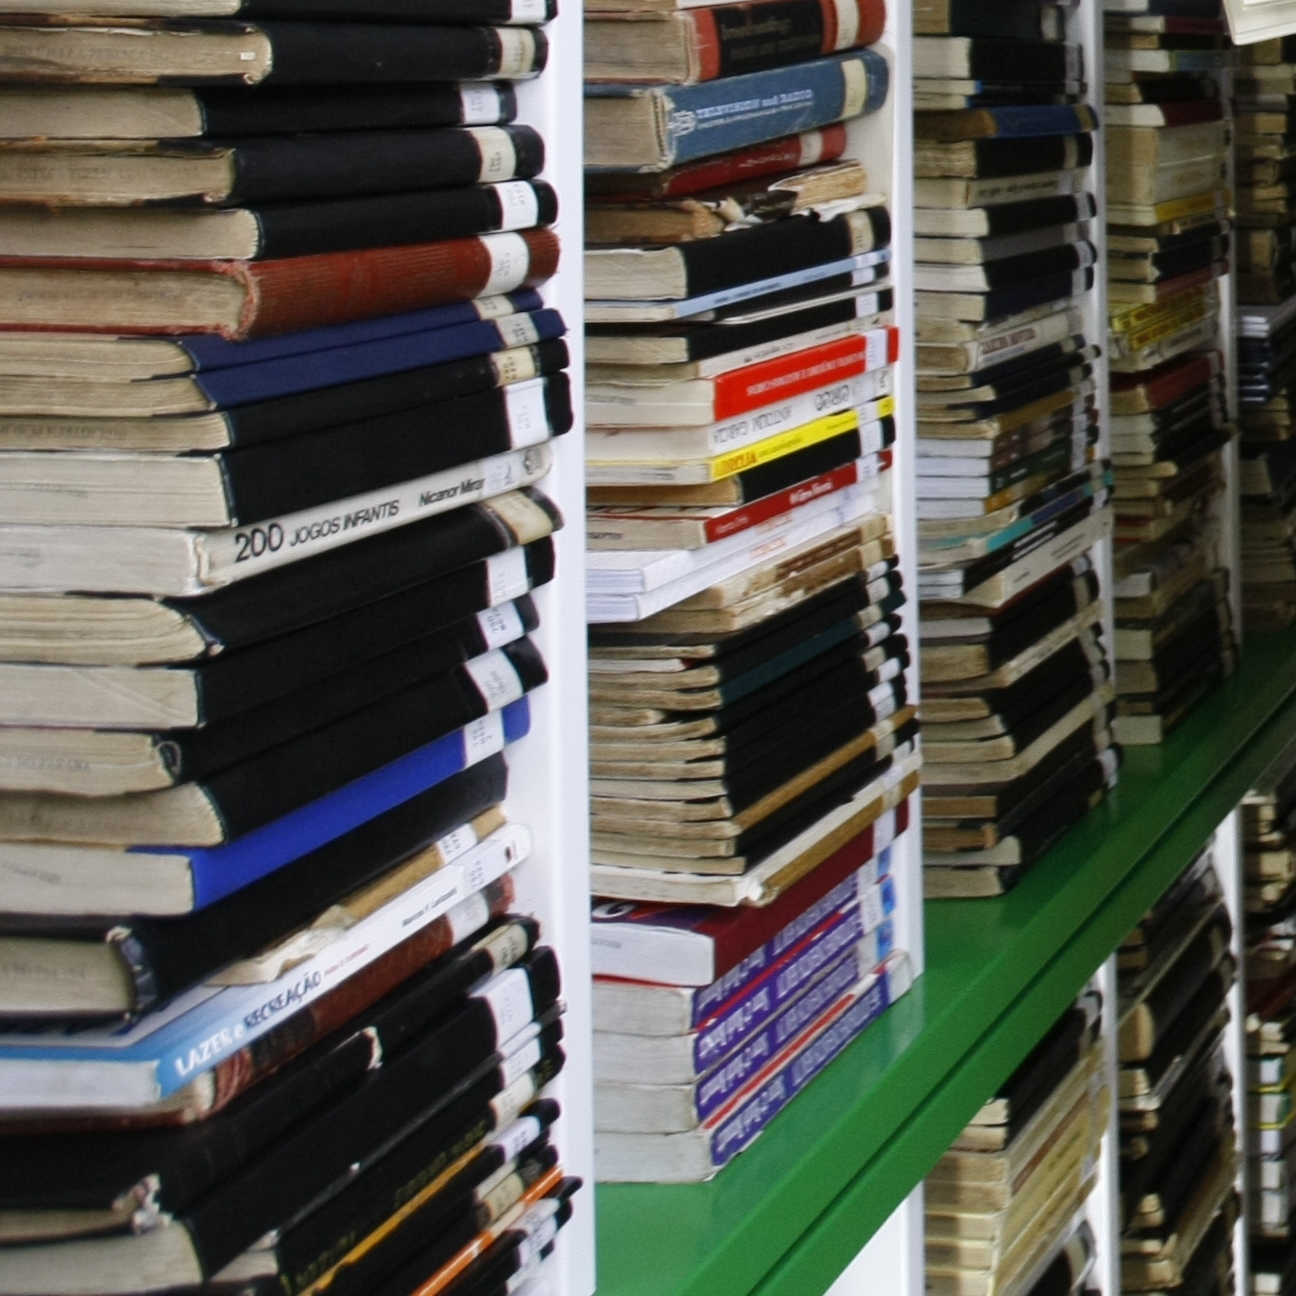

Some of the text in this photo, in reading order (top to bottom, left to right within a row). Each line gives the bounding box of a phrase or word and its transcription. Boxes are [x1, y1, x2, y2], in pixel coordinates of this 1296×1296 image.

[419, 483, 460, 508] Nicanor
[234, 500, 401, 563] 200 JOGOS INFANTIS
[174, 967, 324, 1078] LAZER e RECREAÇÃO
